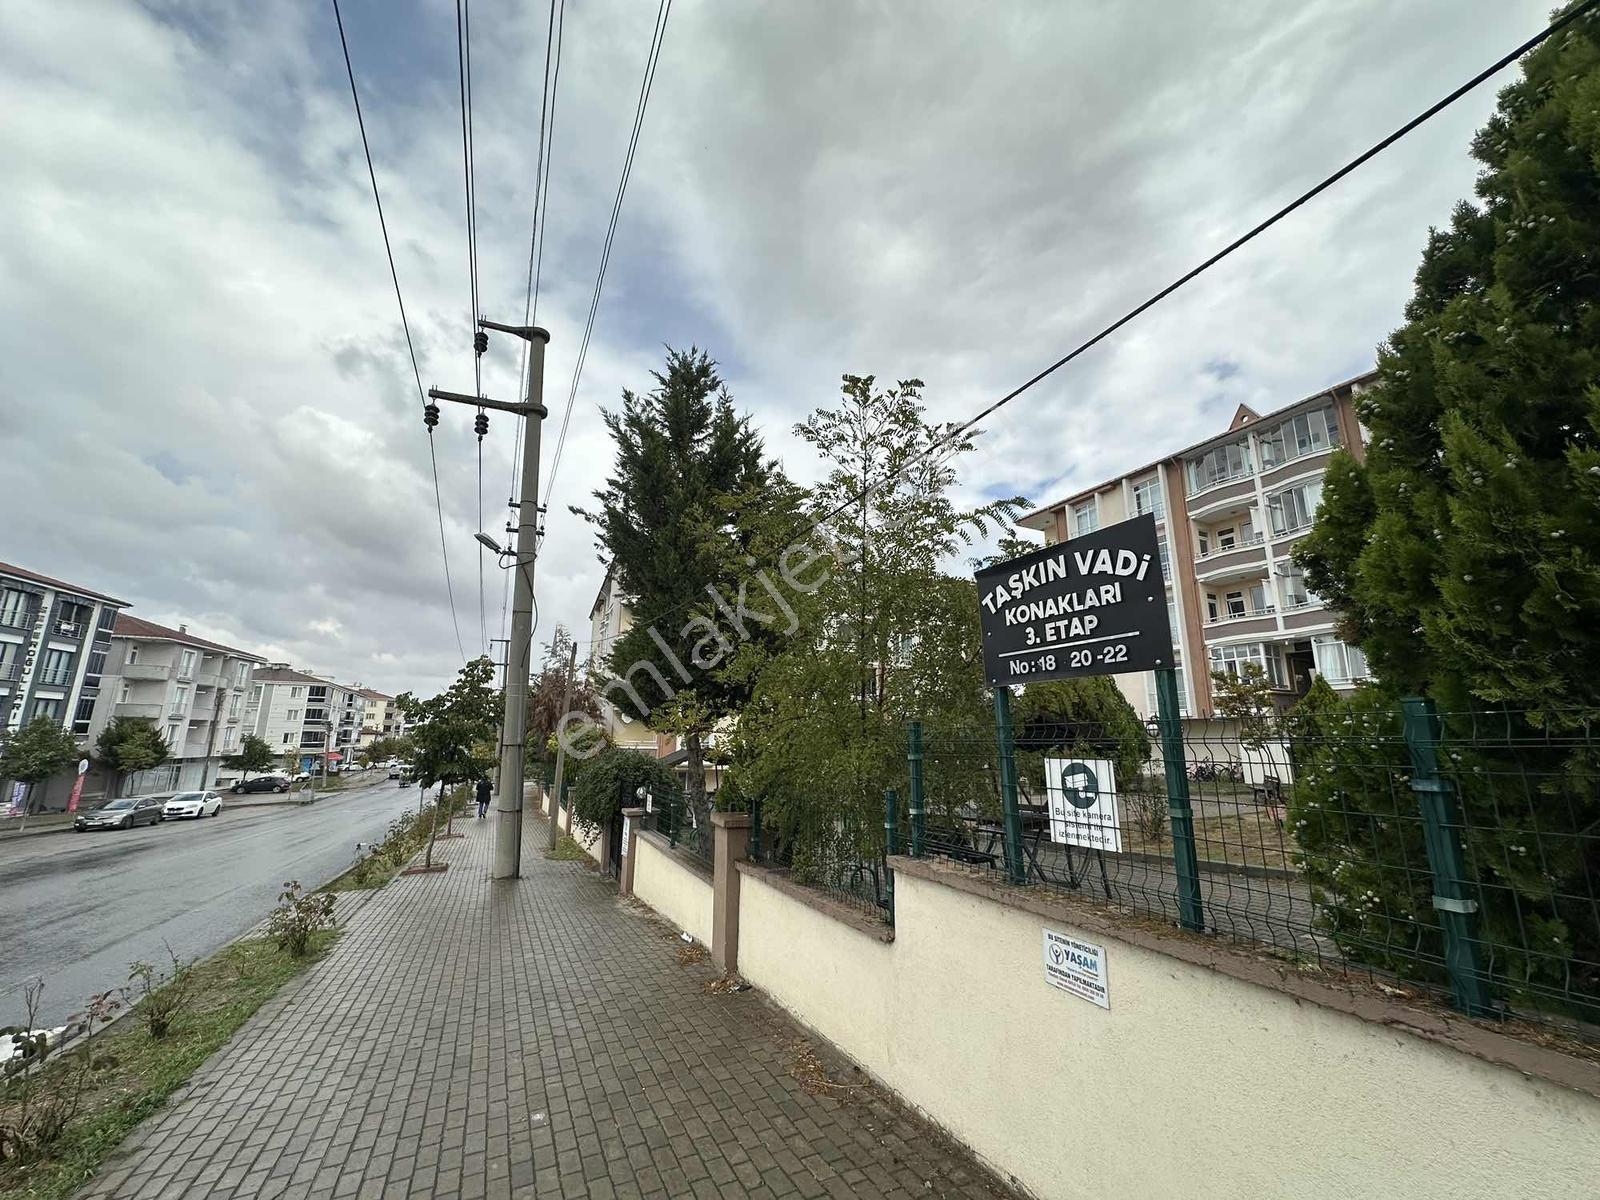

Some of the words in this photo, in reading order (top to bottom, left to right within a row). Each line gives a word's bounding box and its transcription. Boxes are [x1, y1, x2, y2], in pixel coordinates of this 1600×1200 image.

[981, 554, 1067, 614] TAŞKIN
[1005, 582, 1122, 626] KONAKLARI
[1025, 627, 1041, 646] 3.
[1045, 615, 1098, 642] ETAP
[1082, 811, 1112, 821] kamera
[1064, 949, 1098, 972] YAŞAM
